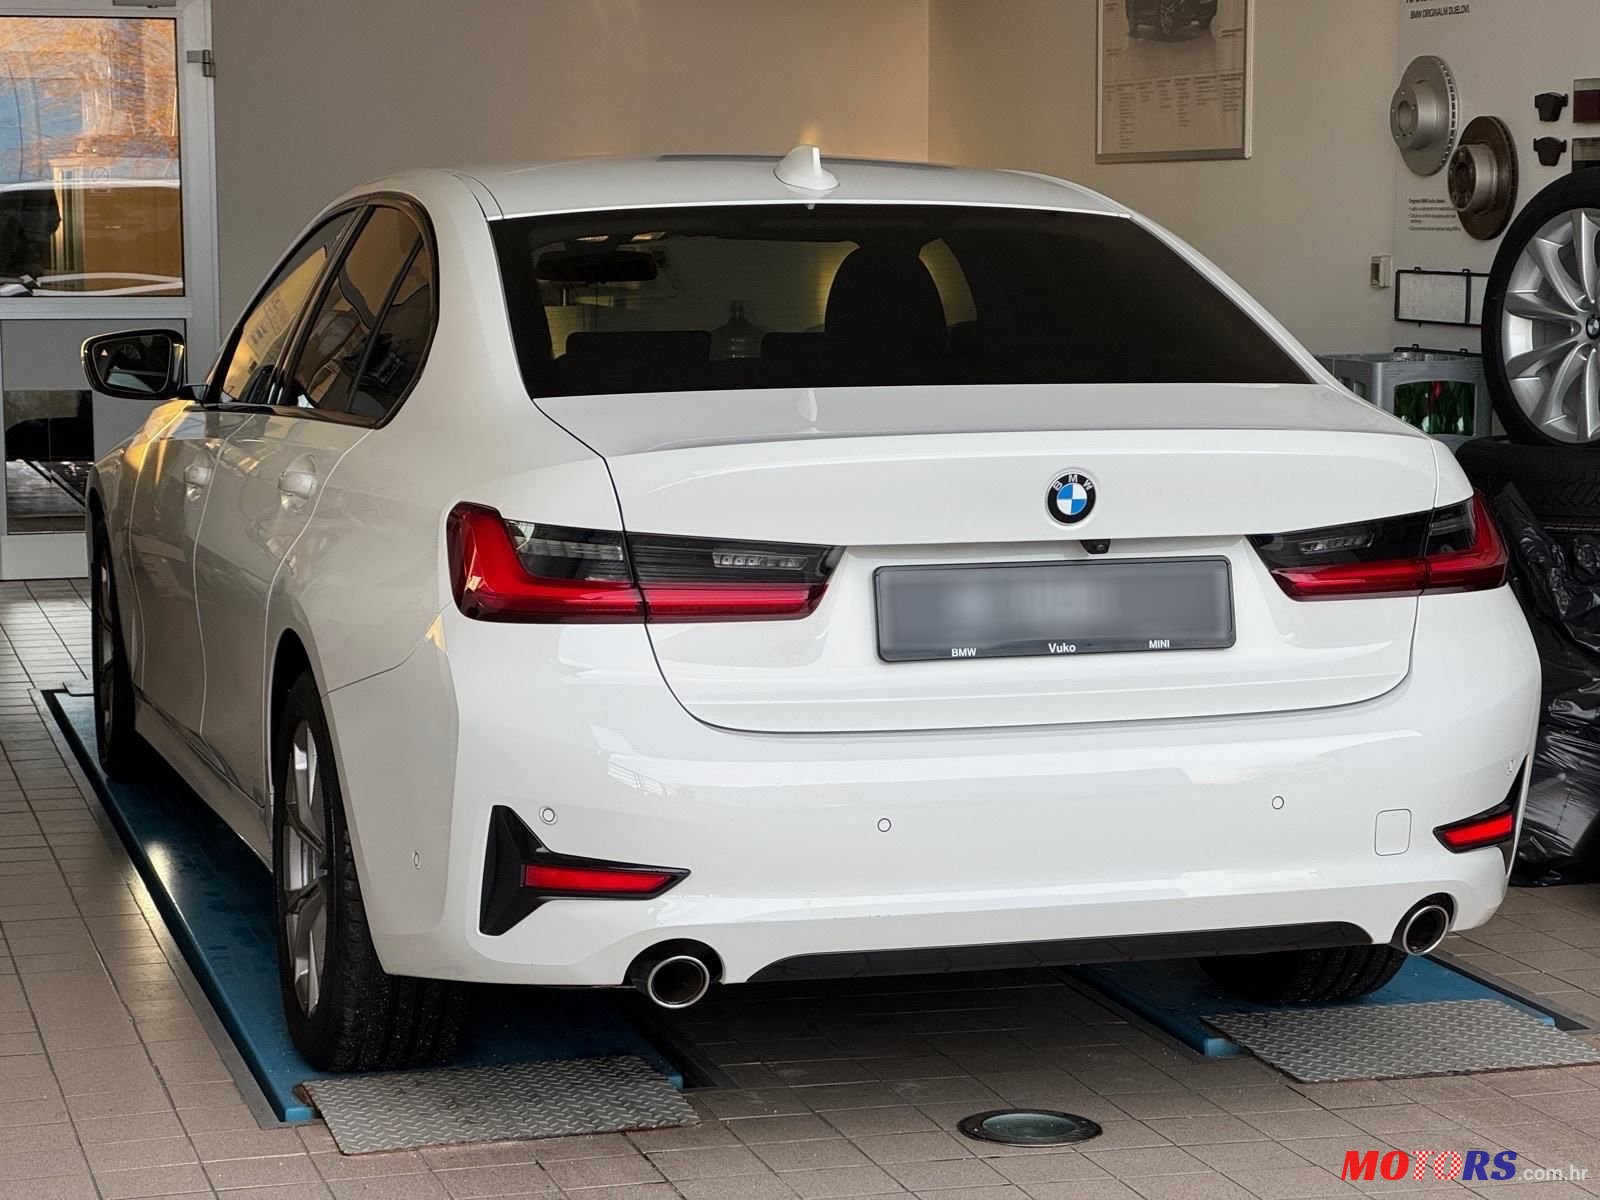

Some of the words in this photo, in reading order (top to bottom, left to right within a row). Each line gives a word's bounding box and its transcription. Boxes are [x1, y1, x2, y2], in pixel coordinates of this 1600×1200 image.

[1410, 10, 1422, 19] BMW
[1053, 474, 1093, 491] BMW
[951, 648, 977, 657] BMW
[1048, 643, 1076, 654] Vuko
[1149, 640, 1170, 649] MINI
